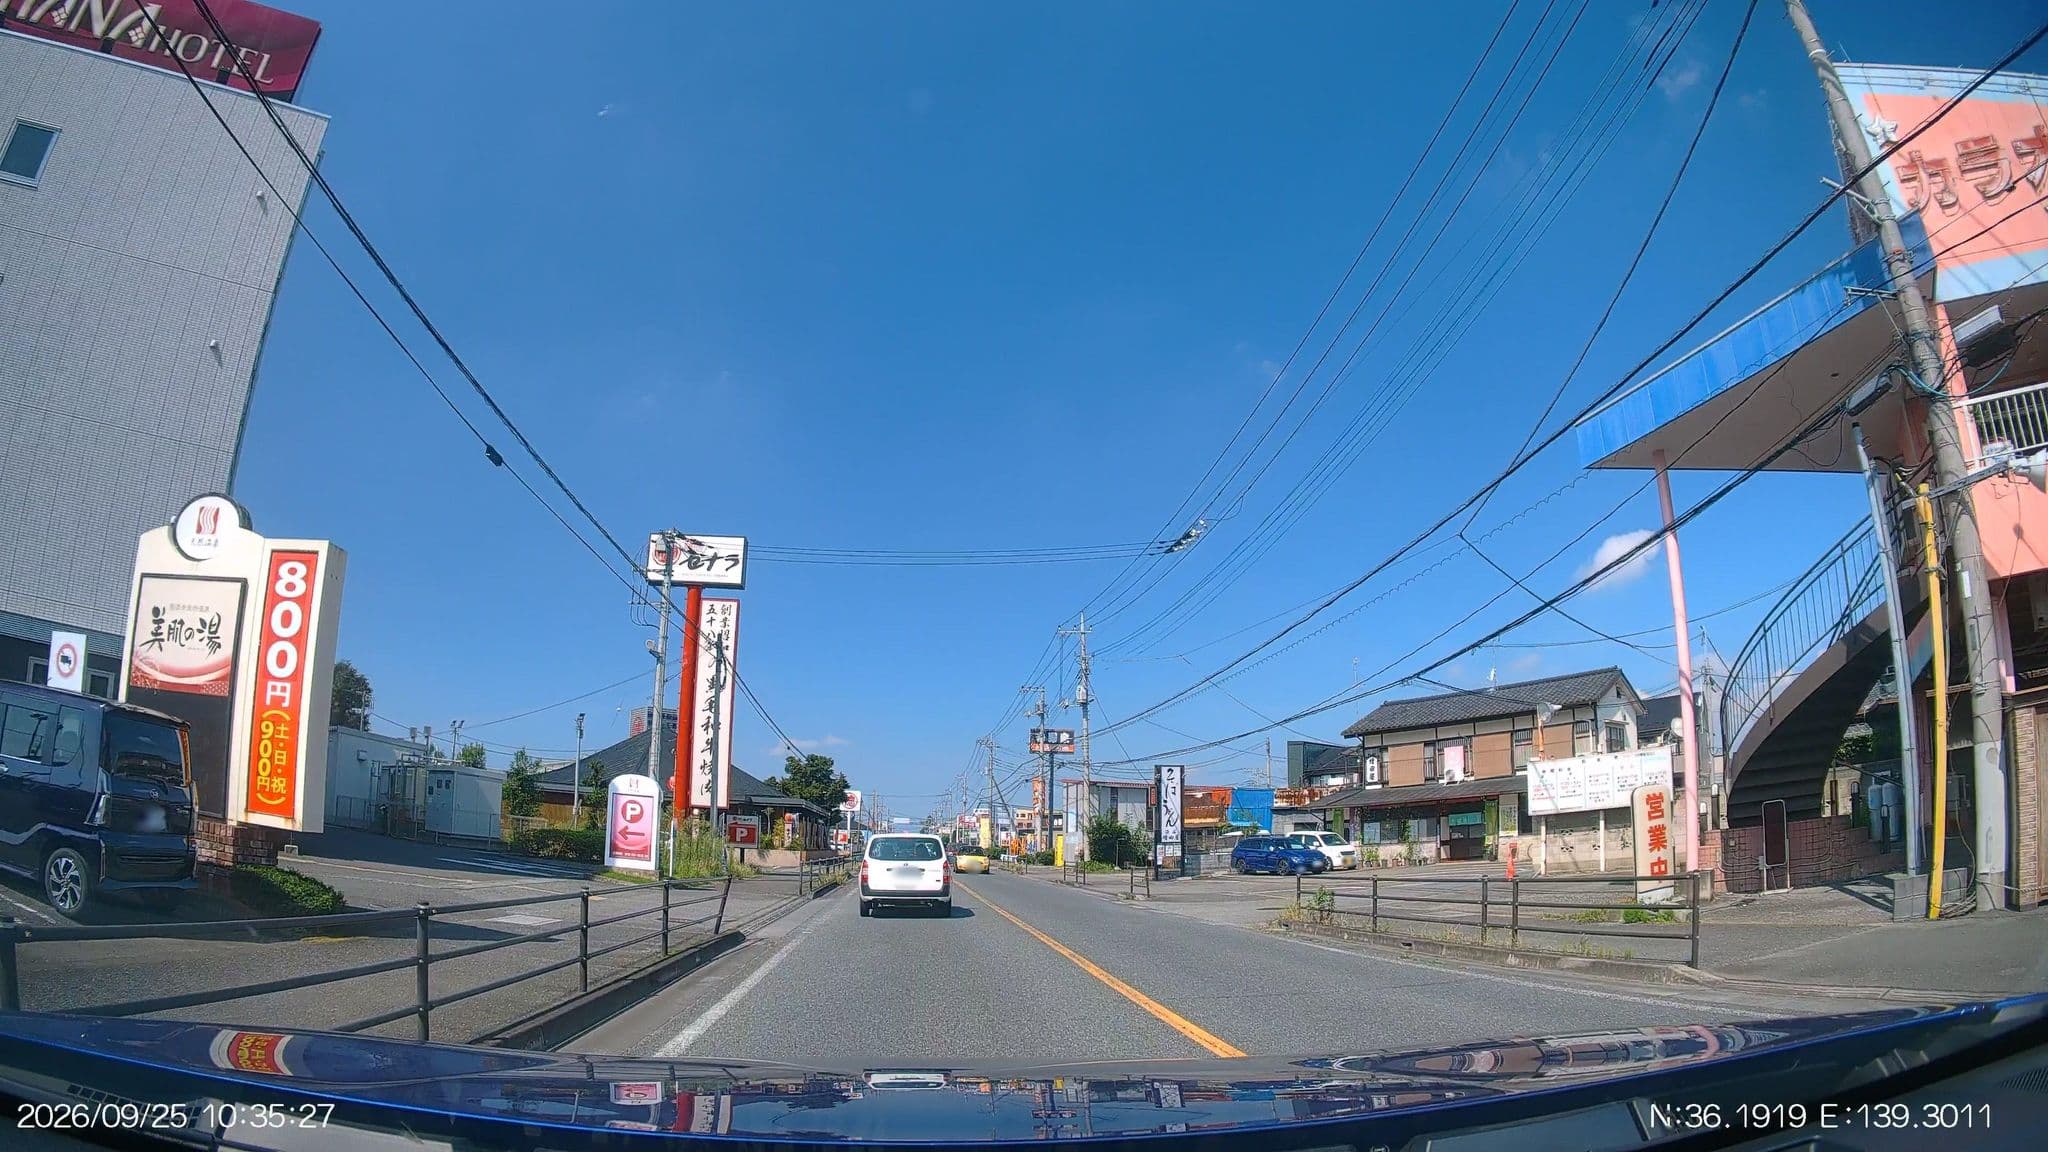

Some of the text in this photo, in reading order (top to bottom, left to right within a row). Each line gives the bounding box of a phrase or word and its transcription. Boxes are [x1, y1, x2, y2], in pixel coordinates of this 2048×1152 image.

[149, 25, 274, 84] HOTEL
[139, 606, 222, 658] 美肌の湯
[263, 560, 307, 707] 800円
[625, 803, 641, 820] P
[736, 828, 748, 841] P
[1645, 792, 1668, 883] 営業中
